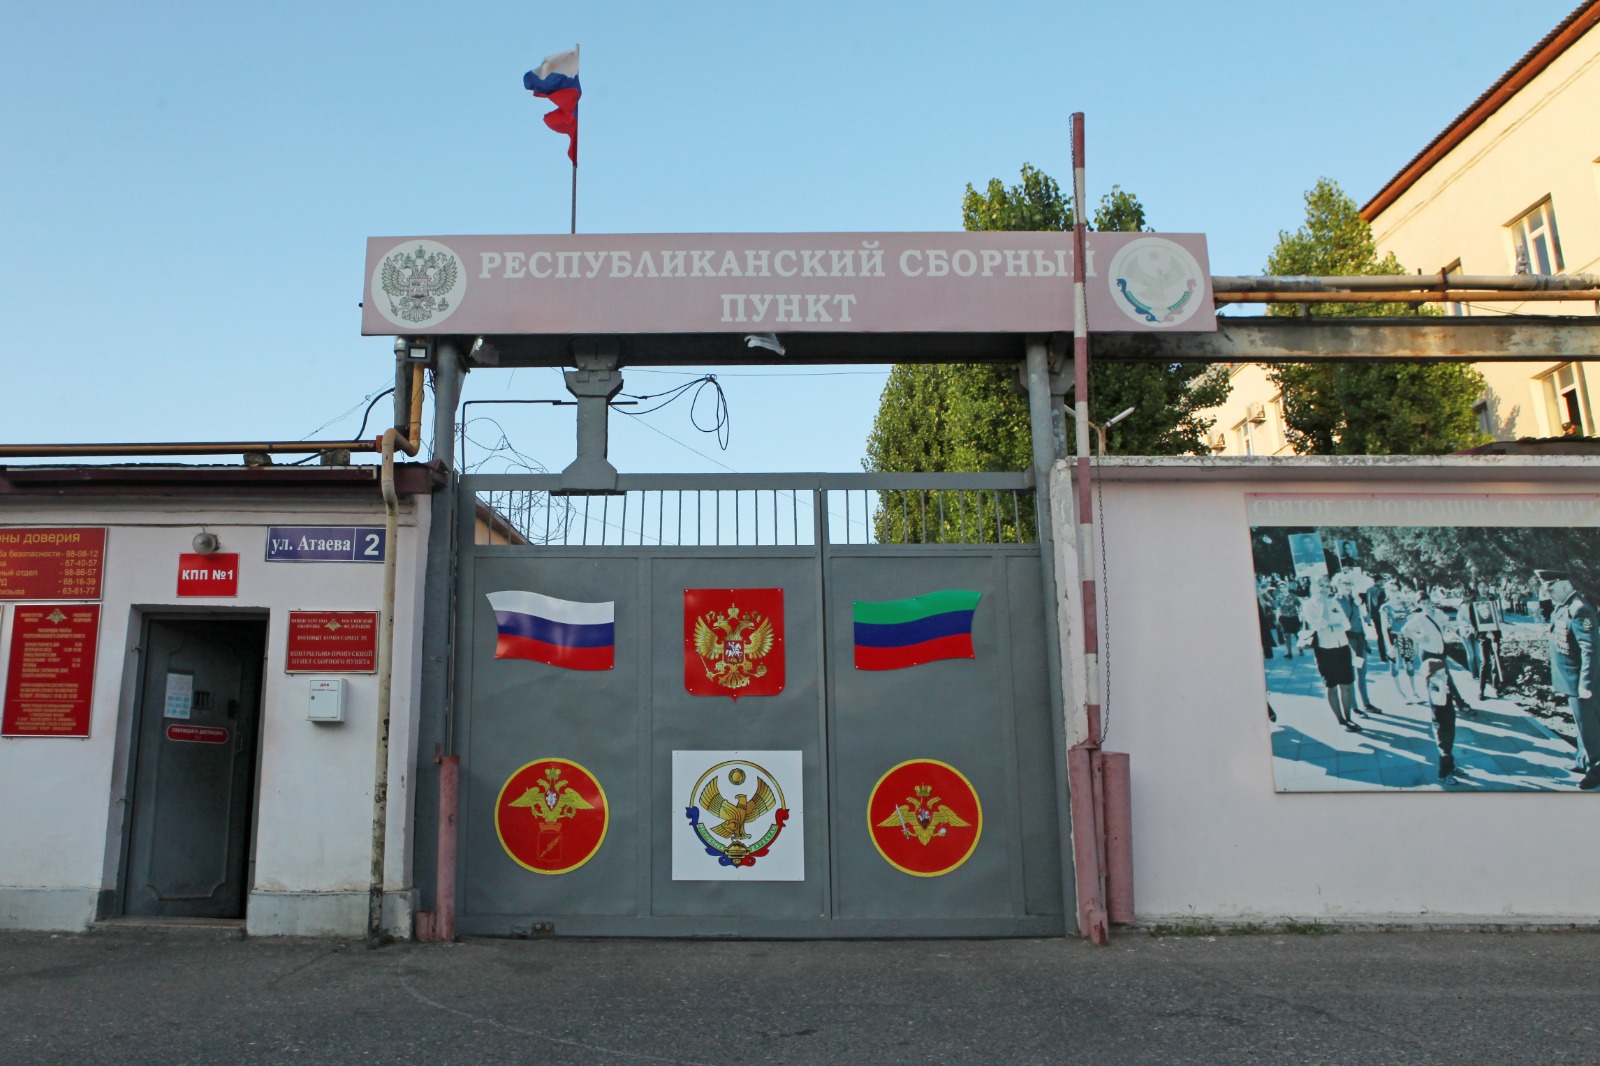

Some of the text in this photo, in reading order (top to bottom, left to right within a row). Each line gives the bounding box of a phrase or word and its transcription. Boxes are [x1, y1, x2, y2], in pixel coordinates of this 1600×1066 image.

[479, 240, 1098, 279] РЕСПУБЛИКАНСКИЙ СБОРНЫЙ
[720, 293, 857, 322] ПУНКТ
[1253, 499, 1335, 516] СВЯТОЕ
[0, 533, 81, 546] ны доверия
[271, 534, 380, 556] ул. Атаева 2
[9, 550, 61, 558] безопасности
[181, 569, 234, 581] КПП №1
